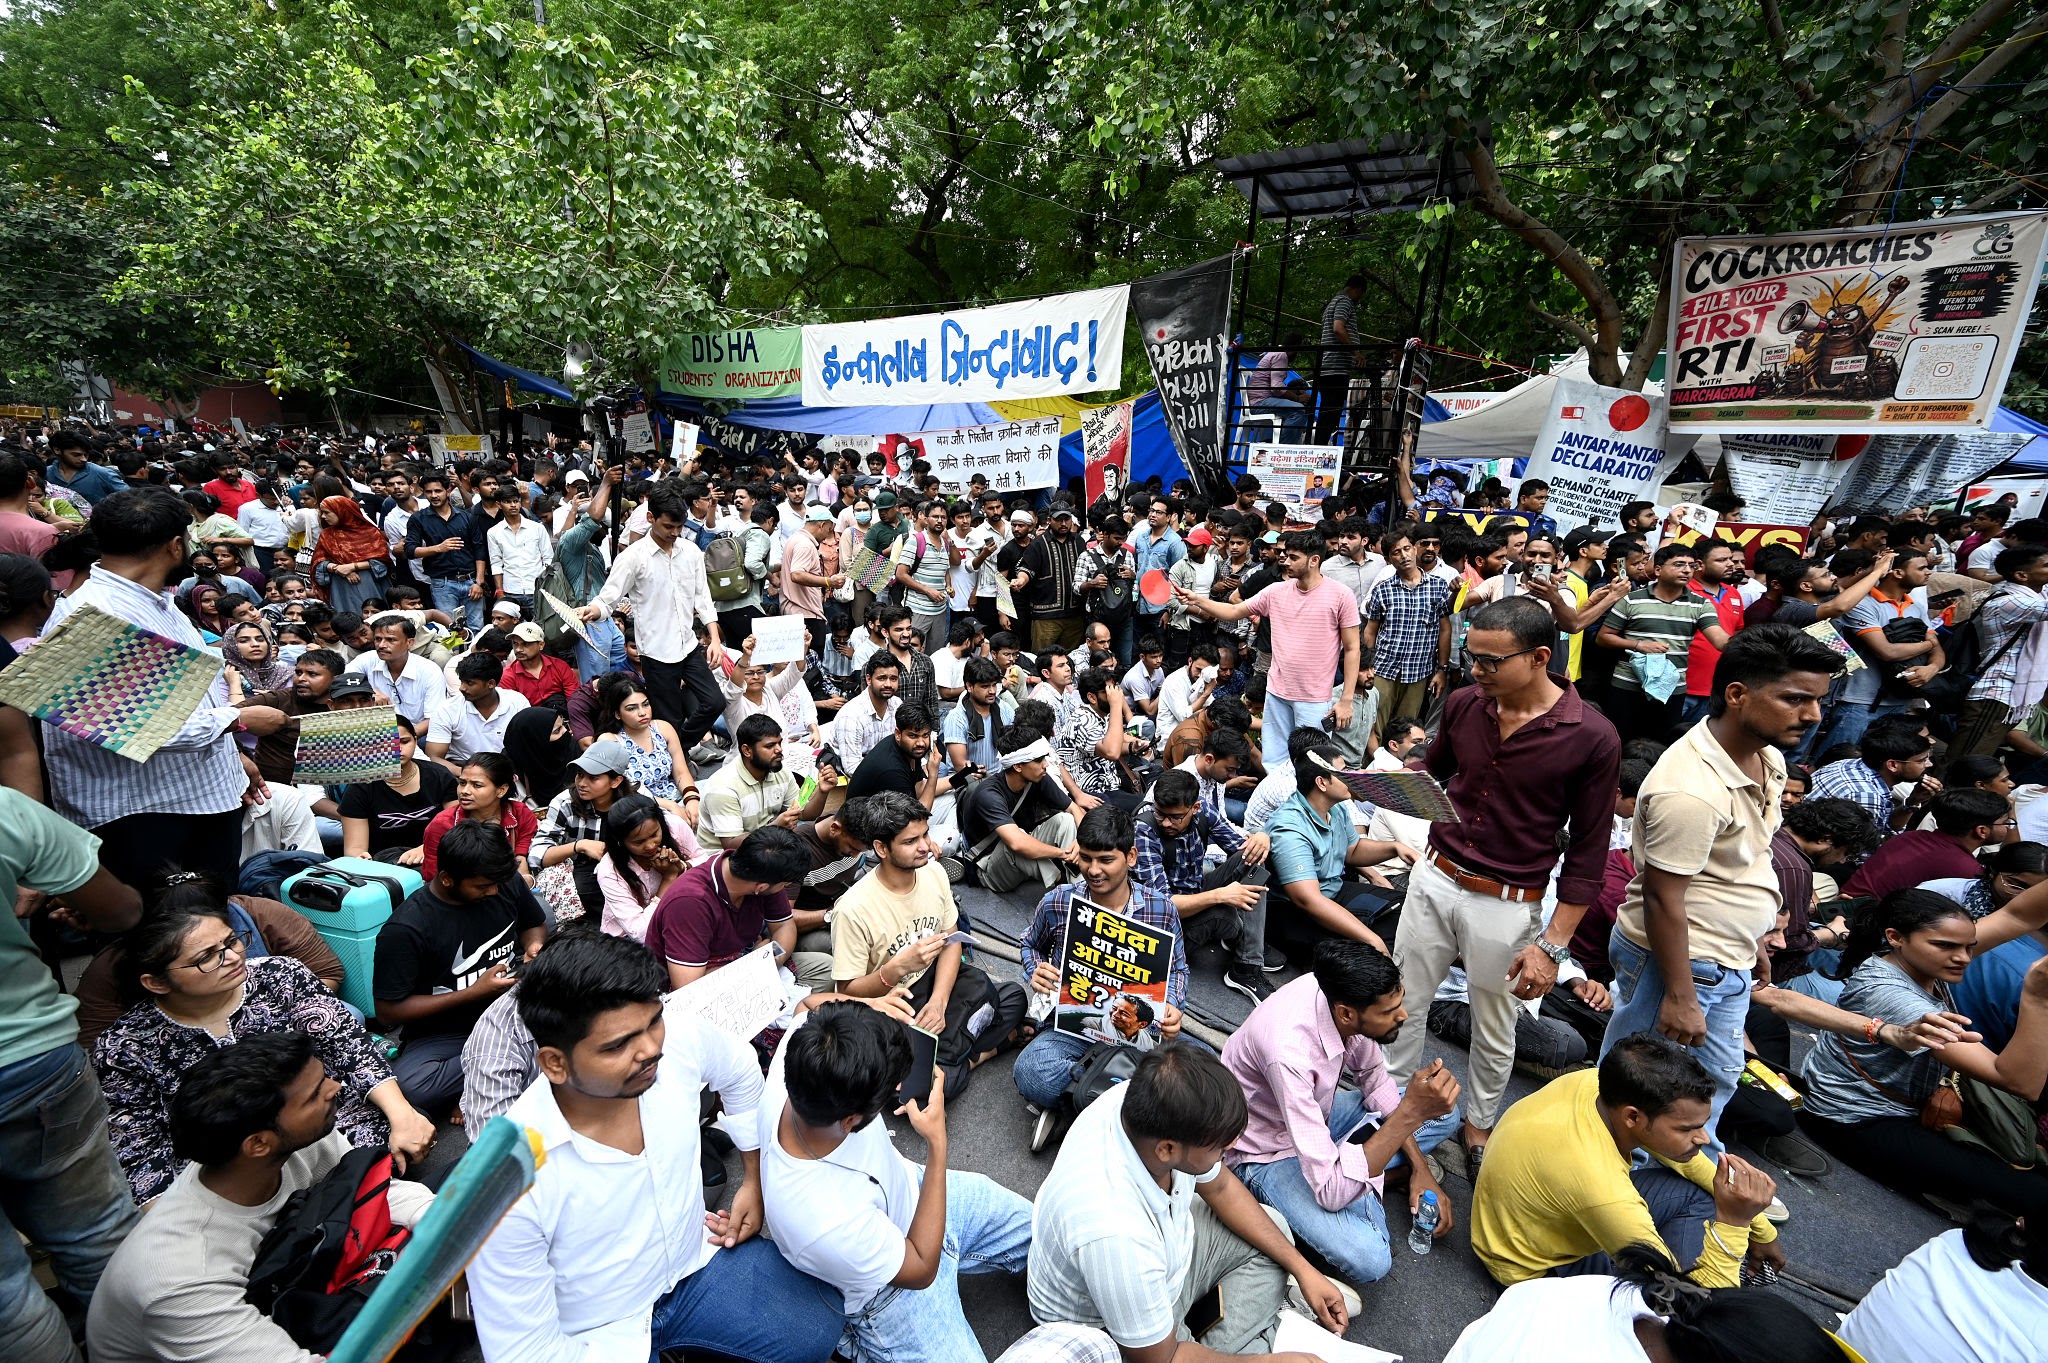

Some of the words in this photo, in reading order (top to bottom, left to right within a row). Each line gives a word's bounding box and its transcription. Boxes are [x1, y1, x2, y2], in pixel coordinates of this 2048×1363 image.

[1972, 235, 2014, 255] CG
[1685, 232, 1937, 293] COCKROACHES
[1943, 263, 1995, 275] INFORMATION
[1949, 274, 1959, 283] IS
[1692, 291, 1731, 315] FILE
[1735, 284, 1780, 305] YOUR
[1939, 297, 1965, 305] DEFEND
[1966, 295, 1985, 303] YOUR
[1946, 289, 1976, 298] DEMAND
[1943, 304, 1966, 312] RIGHT
[1967, 302, 1976, 310] TO
[1675, 304, 1776, 352] FIRST
[1933, 326, 1955, 335] SCAN
[1956, 325, 1982, 334] HERE!
[692, 331, 759, 363] DISHA
[1872, 340, 1899, 348] ANSWERS!
[1676, 337, 1756, 384] RTI
[667, 369, 718, 387] STUDENTS'
[725, 367, 801, 389] ORGANIZATION
[1698, 378, 1722, 387] WITH
[1441, 399, 1454, 410] OF
[1455, 399, 1490, 411] INDIA'
[1717, 410, 1744, 418] DEMAND
[1796, 409, 1817, 417] BUILD
[1886, 405, 1908, 413] RIGHT
[1921, 404, 1969, 412] INFORMATION
[1916, 412, 1927, 420] TO
[1557, 431, 1609, 454] JANTAR
[1609, 441, 1666, 464] MANTAR
[1735, 434, 1824, 451] DECLARATION
[1037, 443, 1053, 462] की
[1294, 455, 1317, 464] इंडिया
[1551, 446, 1655, 482] DECLARATIO
[996, 472, 1011, 489] होती
[1598, 477, 1611, 486] THE
[1550, 476, 1593, 495] DEMAND
[1594, 487, 1638, 503] CHARTE
[1558, 490, 1587, 503] STUDENTS
[1587, 497, 1602, 506] AND
[1556, 505, 1589, 519] EDUCATION
[1559, 498, 1583, 510] RADICAL
[1584, 504, 1613, 516] CHANGE
[1077, 906, 1095, 928] मैं
[1095, 912, 1159, 955] जिंदा
[1091, 936, 1113, 954] था
[1116, 944, 1137, 963] तो
[1072, 941, 1100, 964] आ
[1103, 953, 1151, 984] गया
[1068, 959, 1092, 978] क्या
[1094, 969, 1123, 990] आप
